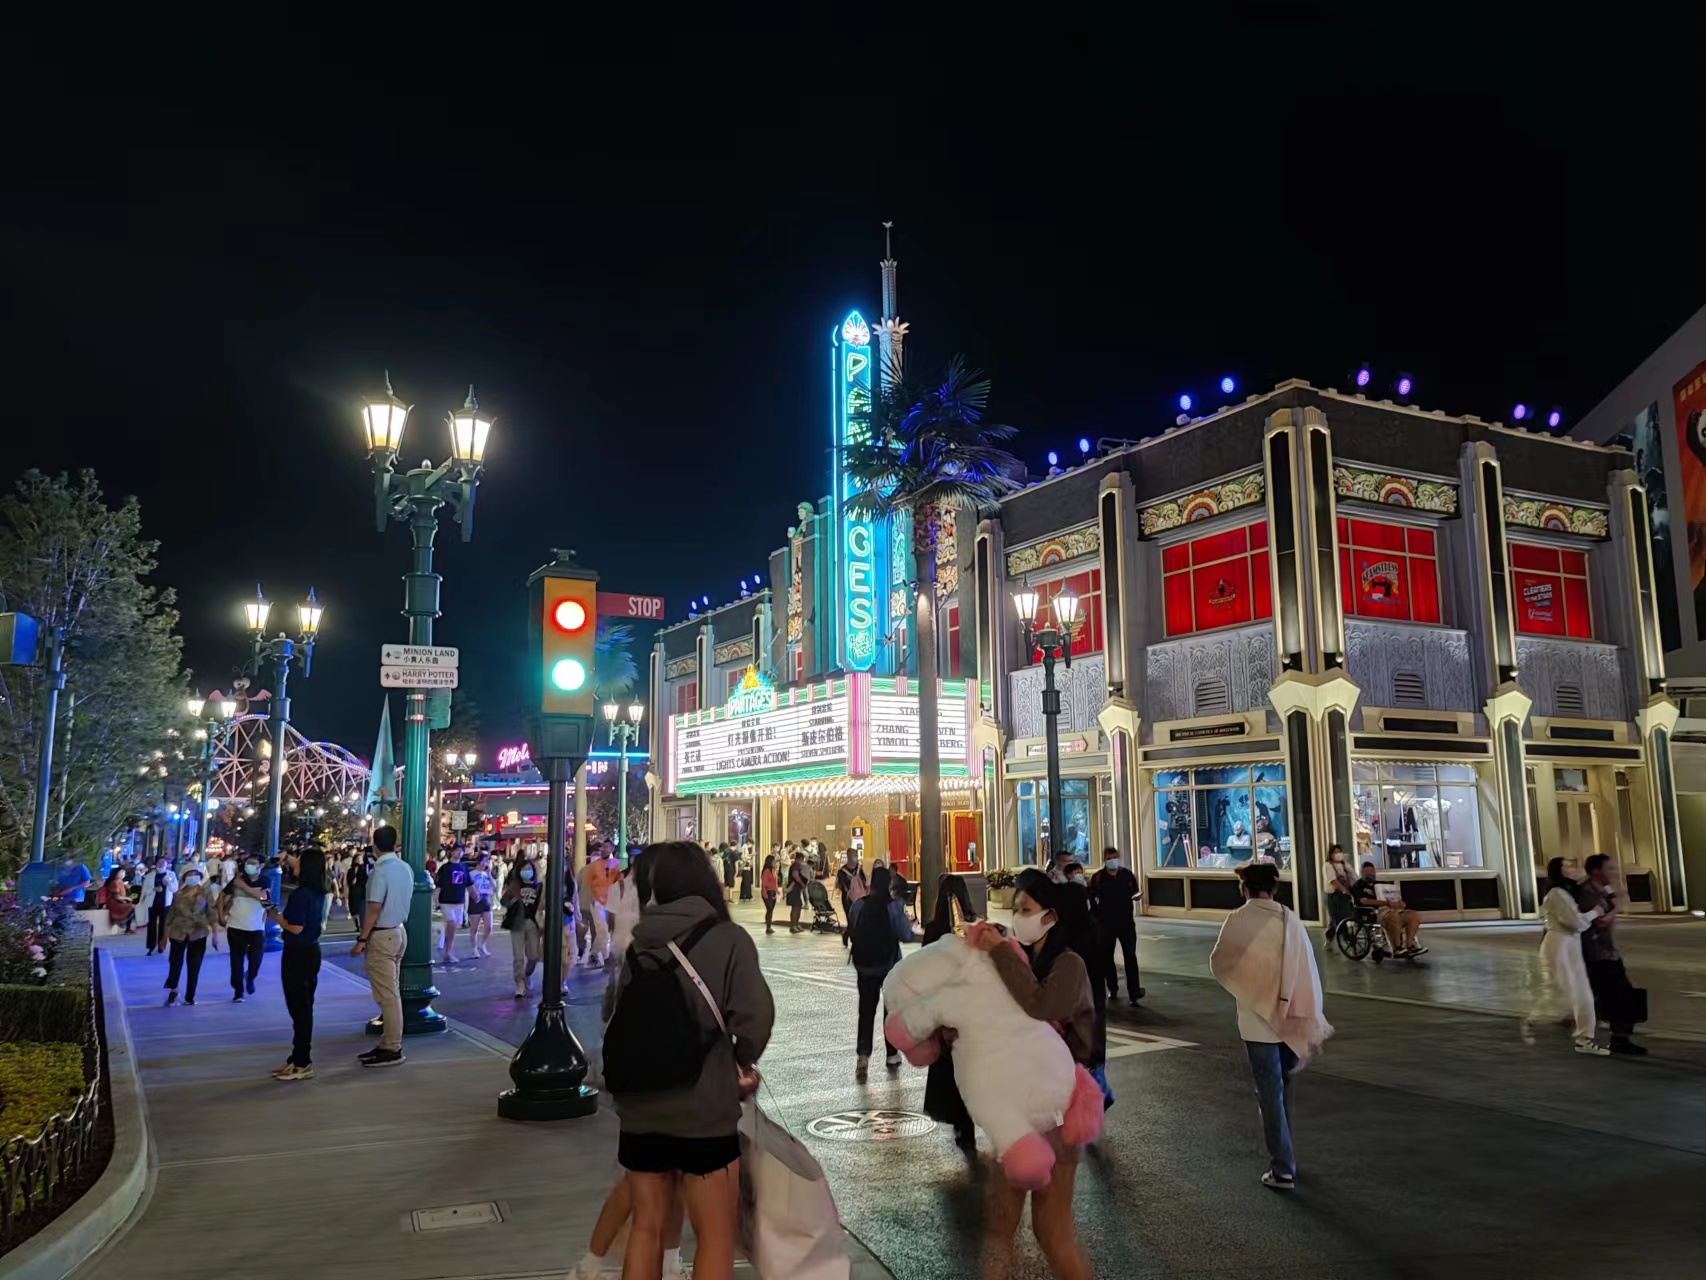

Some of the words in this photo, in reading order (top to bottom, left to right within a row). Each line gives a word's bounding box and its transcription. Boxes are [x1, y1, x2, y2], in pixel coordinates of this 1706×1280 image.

[628, 596, 661, 617] STOP
[403, 647, 433, 656] MINION
[402, 670, 427, 678] HARRY
[428, 671, 455, 679] POTTER
[876, 724, 909, 734] ZHANG
[876, 737, 909, 747] YIMOU
[716, 758, 736, 771] LIGHTS
[736, 754, 762, 768] CAMERA
